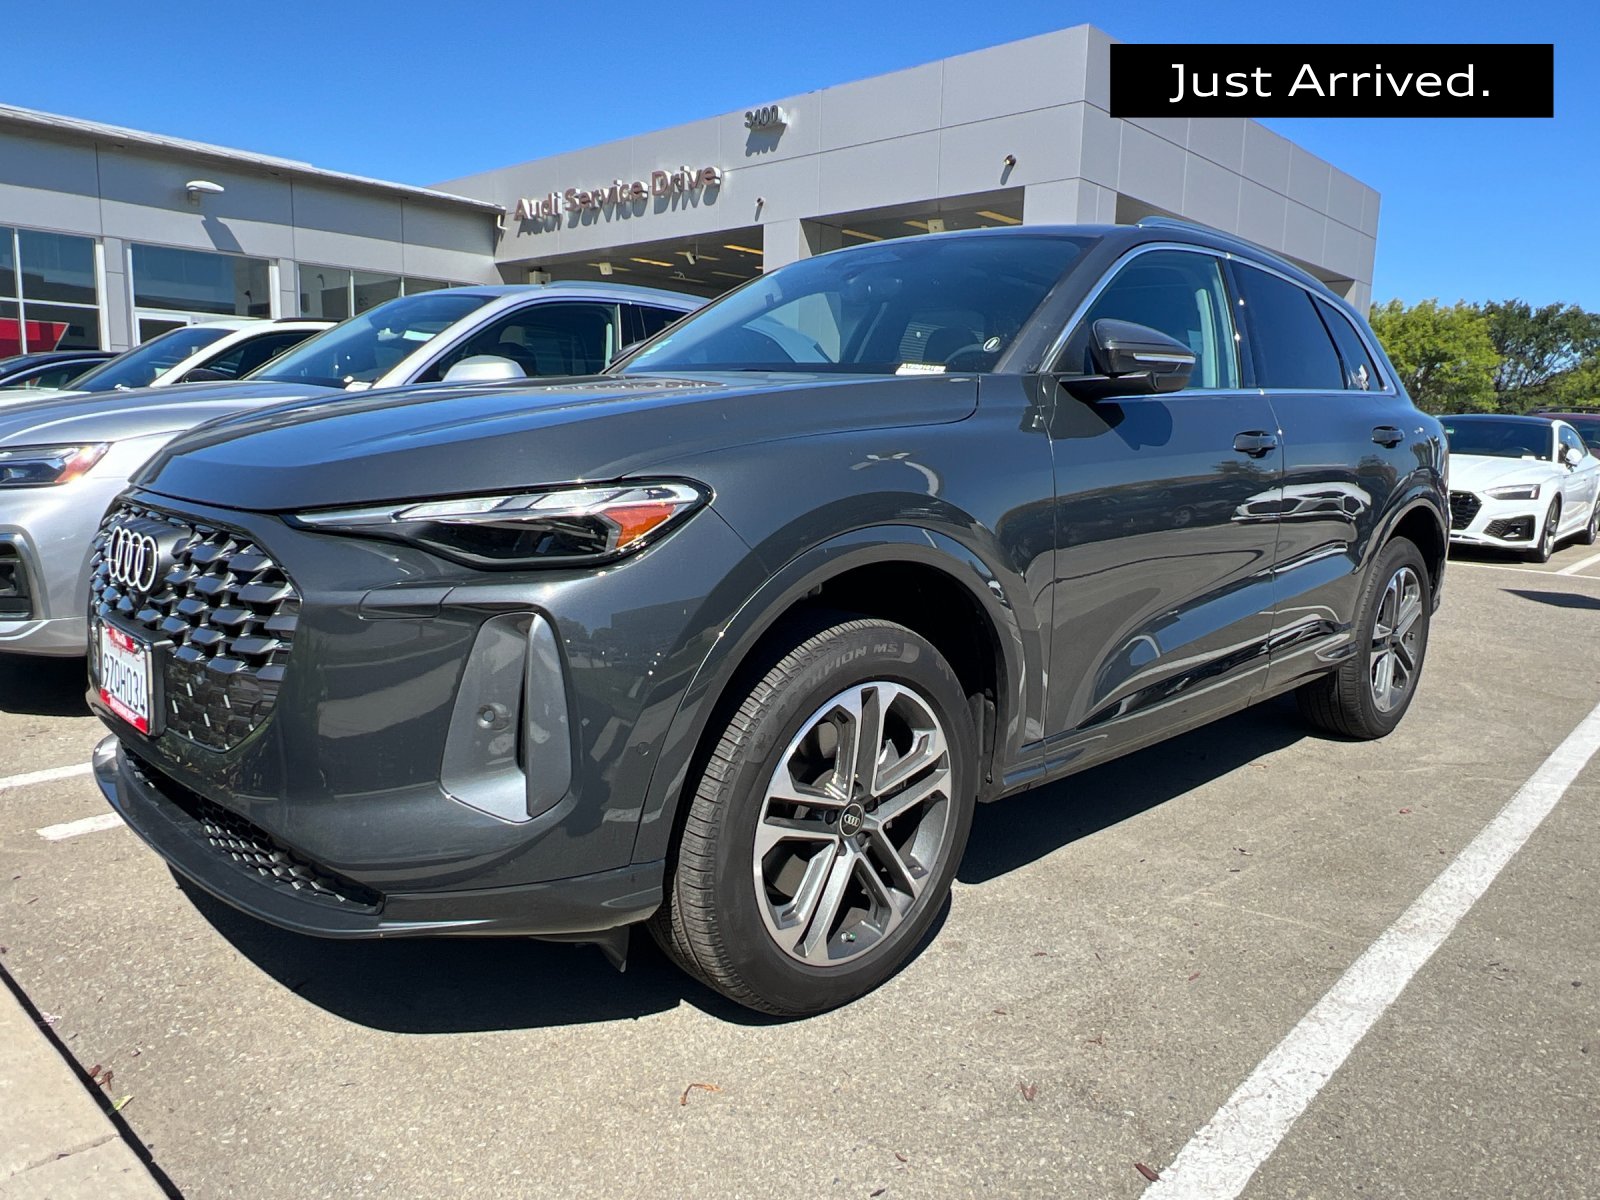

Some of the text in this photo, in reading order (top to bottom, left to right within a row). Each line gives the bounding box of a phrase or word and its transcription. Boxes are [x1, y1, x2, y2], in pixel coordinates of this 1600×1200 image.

[744, 104, 782, 128] 3400
[514, 165, 720, 221] Audi Service Drive
